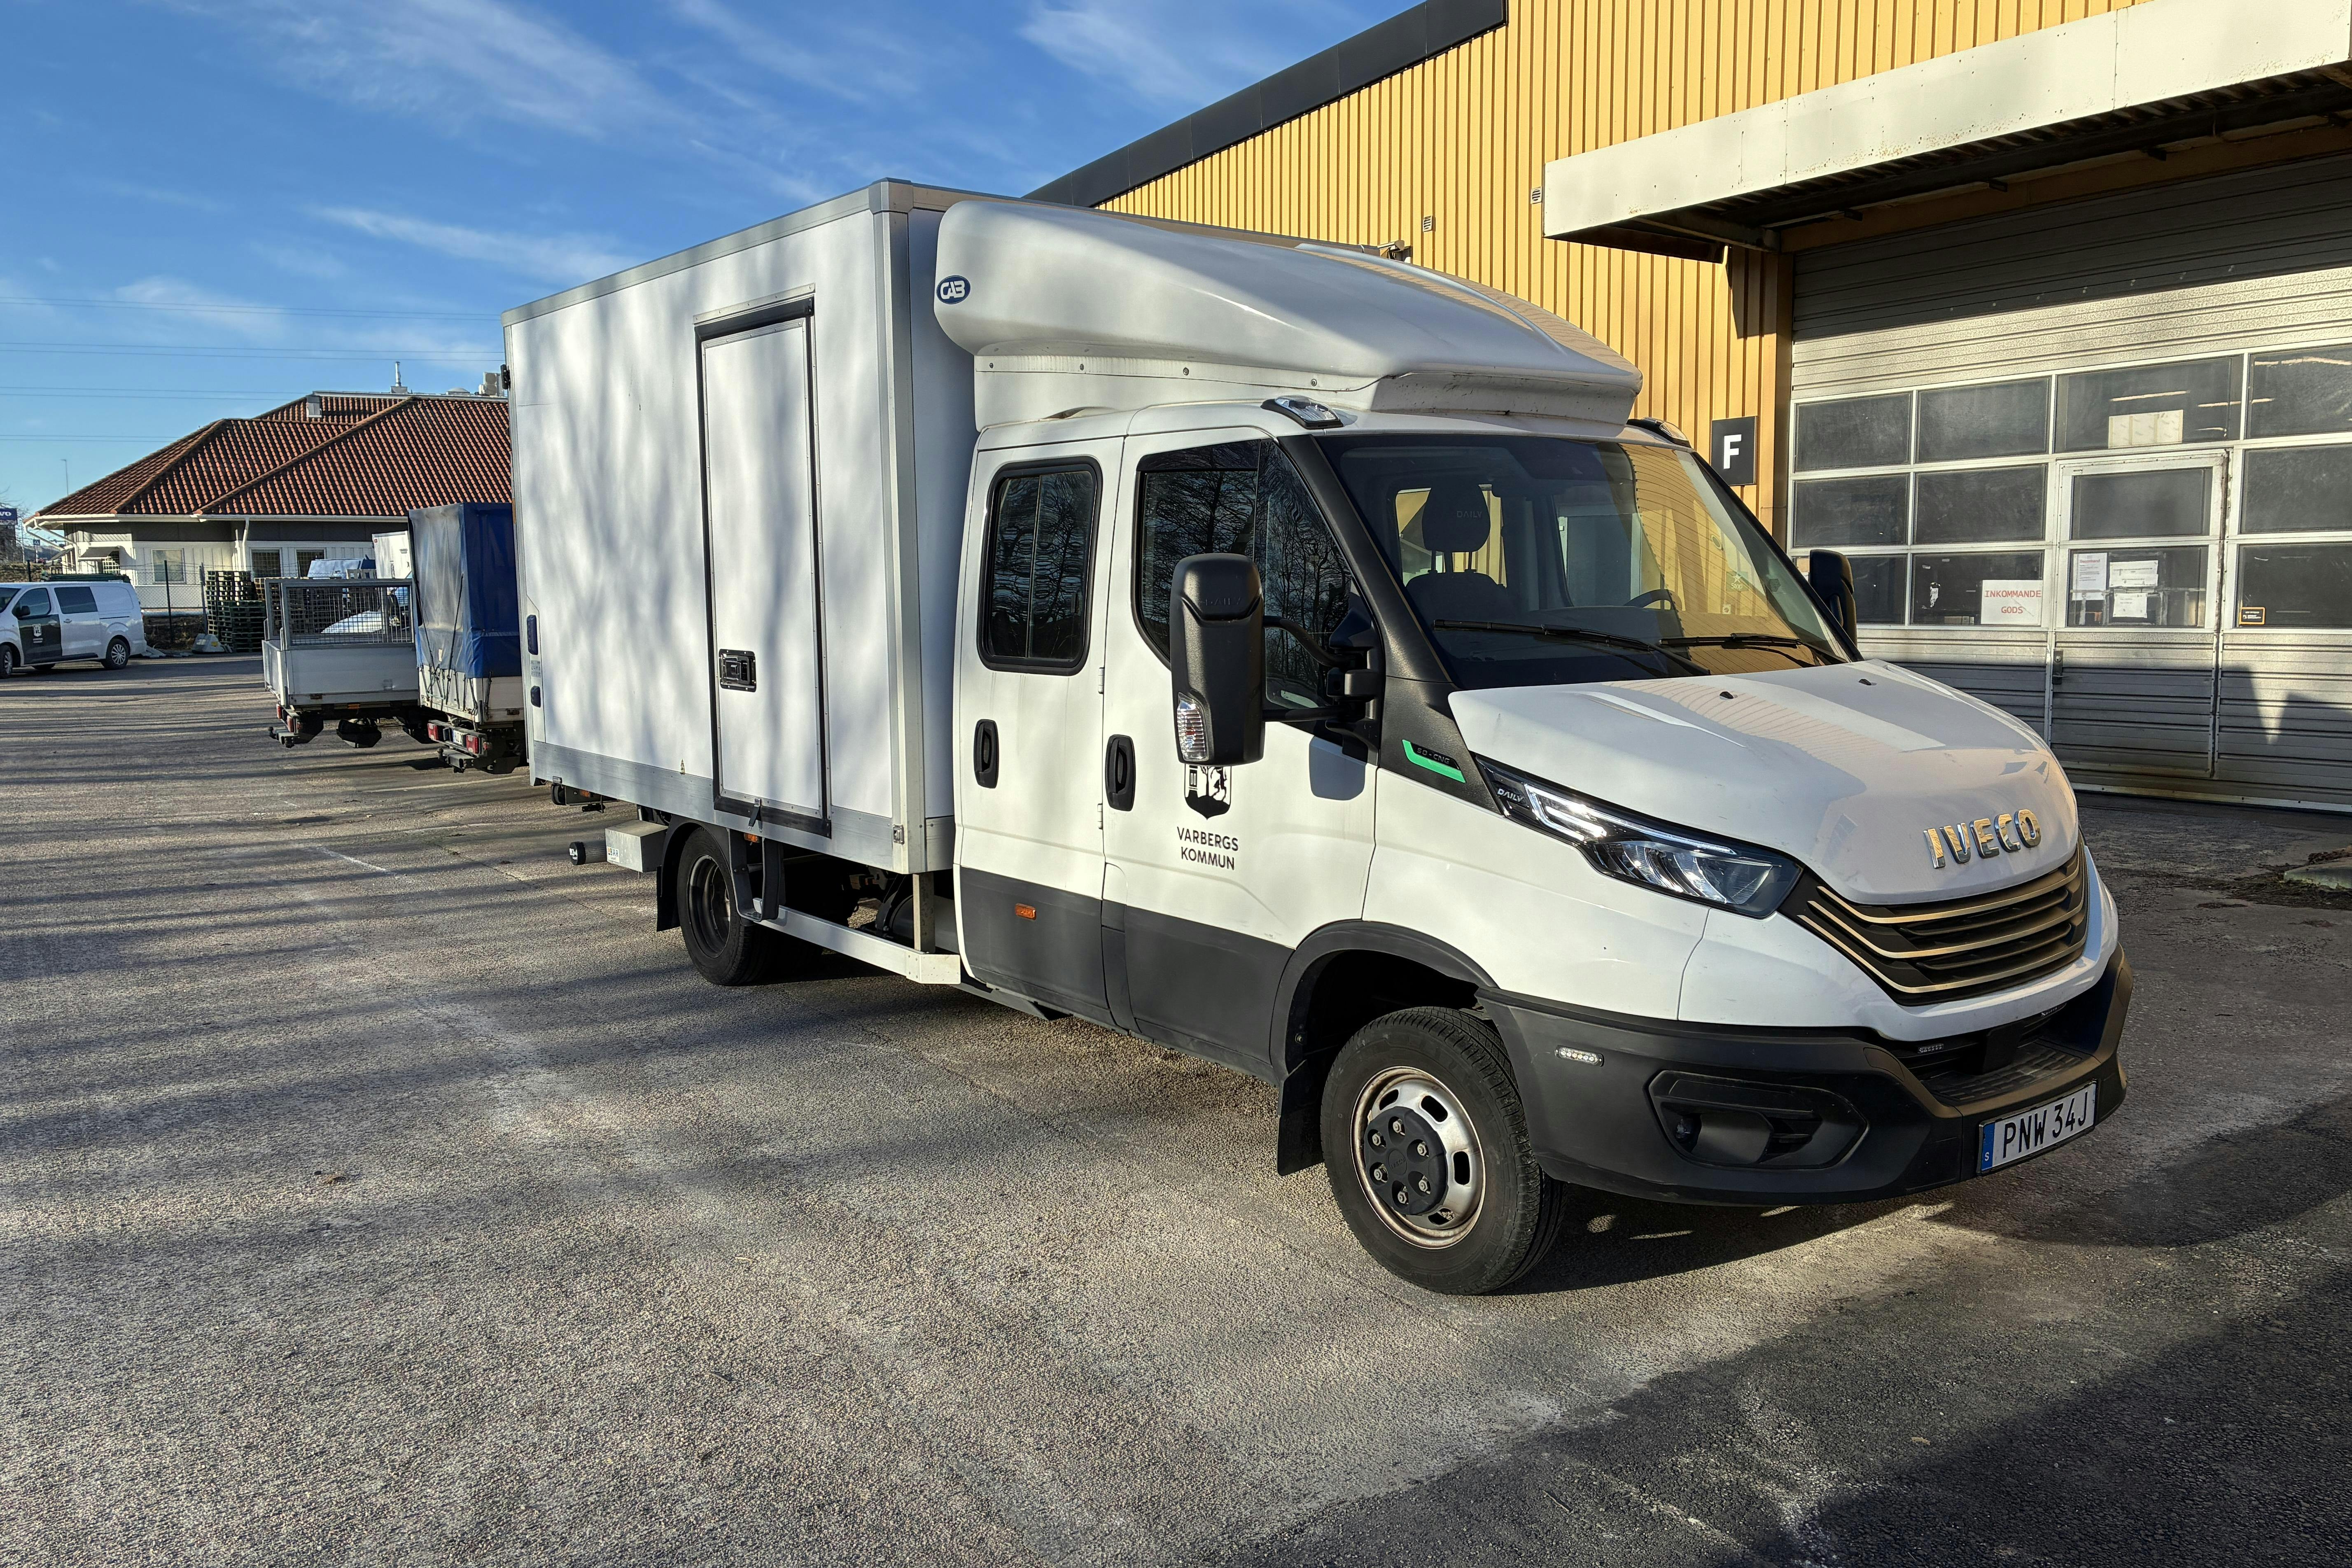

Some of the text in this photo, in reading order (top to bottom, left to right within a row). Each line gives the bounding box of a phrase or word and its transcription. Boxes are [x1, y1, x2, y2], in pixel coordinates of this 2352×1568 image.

[940, 280, 965, 300] CAB
[1723, 434, 1742, 469] F
[1497, 788, 1525, 802] DAILY
[1177, 826, 1239, 851] VARBERGS
[1923, 809, 2042, 869] IVECO
[1181, 846, 1234, 870] KOMMUN
[2003, 1091, 2088, 1159] PNW 34J
[1984, 1152, 1990, 1162] S
